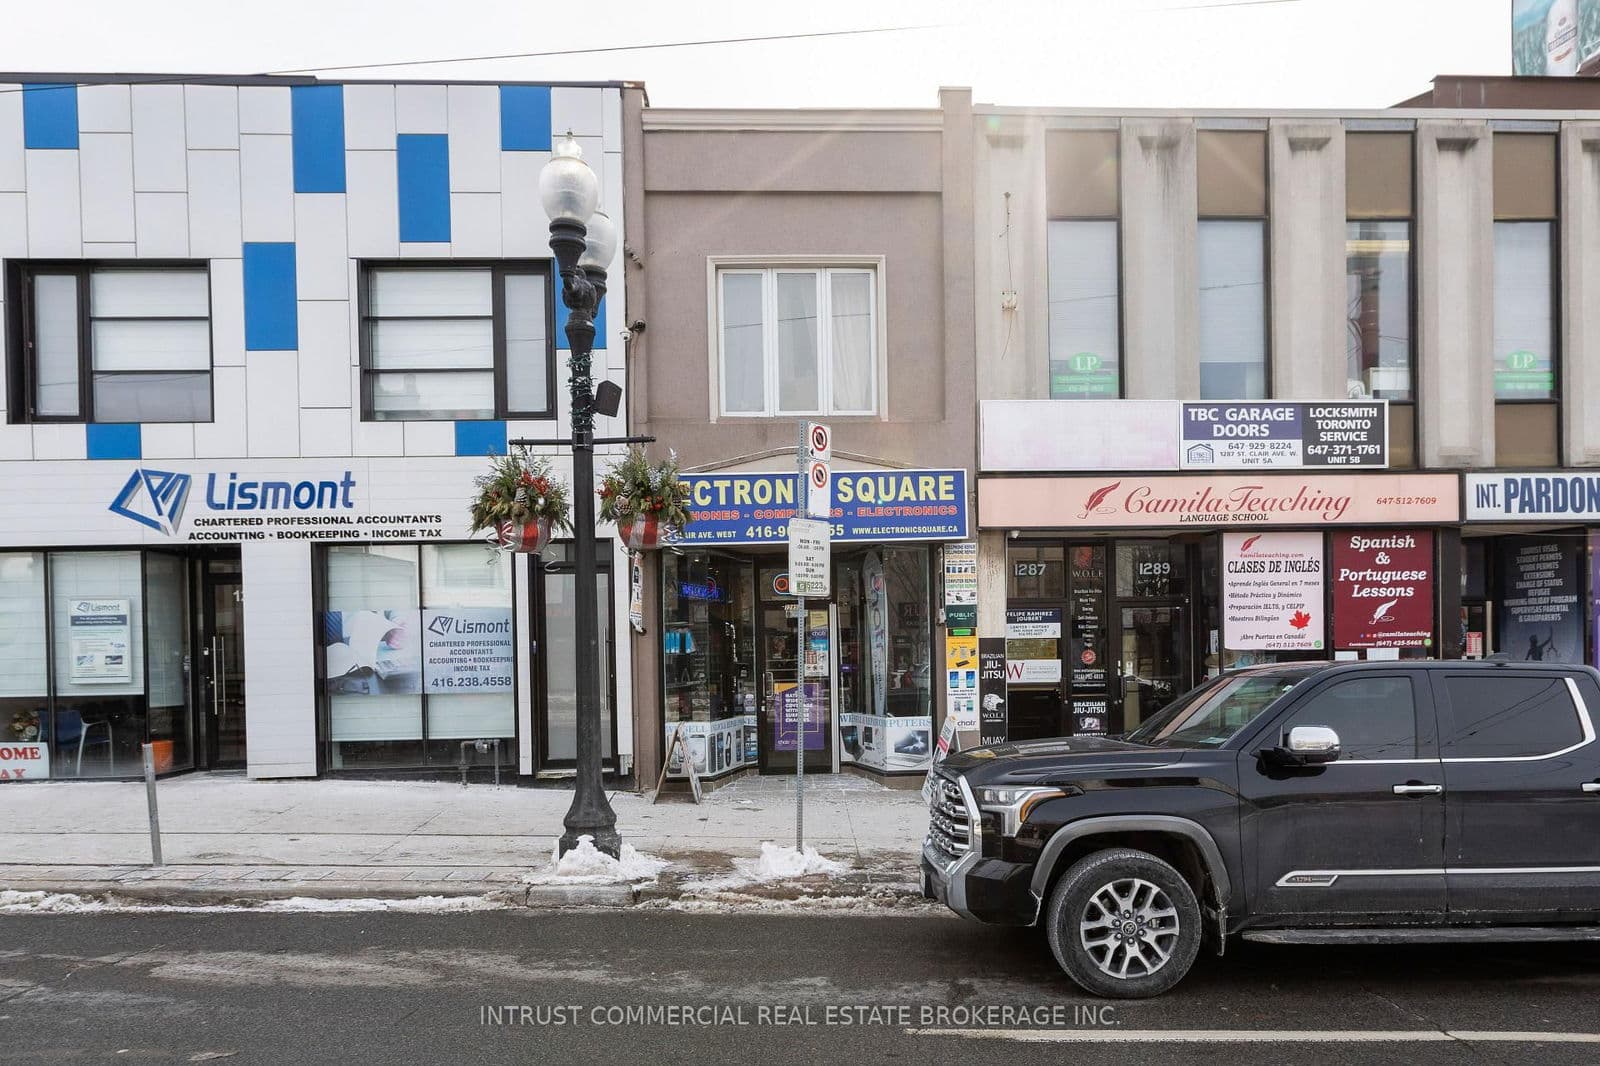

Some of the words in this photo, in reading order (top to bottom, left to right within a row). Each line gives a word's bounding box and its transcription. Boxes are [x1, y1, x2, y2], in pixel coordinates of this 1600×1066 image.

[1076, 356, 1097, 371] LP
[1512, 354, 1534, 369] LP
[1188, 408, 1219, 421] TBC
[1225, 407, 1295, 421] GARAGE
[1309, 407, 1377, 418] LOCKSMITH
[1212, 423, 1270, 437] DOORS
[1315, 419, 1371, 430] TORONTO
[1319, 431, 1368, 442] SERVICE
[1307, 444, 1381, 455] 647-371-1761
[1327, 456, 1347, 464] UNIT
[1350, 456, 1361, 464] 5B
[205, 471, 357, 510] Lismont
[837, 475, 955, 504] SQUARE
[1476, 483, 1501, 509] INT.
[1504, 477, 1600, 514] PARDON
[1124, 486, 1224, 514] Camila
[1225, 485, 1352, 521] Teaching
[1376, 497, 1437, 505] 647-512-7609
[689, 509, 741, 521] HONES
[753, 506, 844, 520] COMPRS
[856, 505, 958, 517] ELECTRONICS
[1179, 513, 1230, 522] LANGUAGE
[1232, 513, 1269, 521] SCHOOL
[193, 515, 264, 527] CHARTERED
[266, 515, 355, 526] PROFESSIONAL
[356, 513, 443, 525] ACCOUNTANTS
[188, 530, 266, 541] ACCOUNTING
[276, 529, 360, 540] BOOKKEEPING
[371, 528, 417, 539] INCOME
[419, 528, 443, 538] TAX
[697, 530, 715, 539] AVE.
[716, 530, 737, 538] WEST
[852, 525, 958, 535] WWW.ELECTRONICSQUARE.CA
[1350, 535, 1416, 552] Spanish
[1375, 551, 1391, 565] &
[1014, 563, 1047, 577] 1287
[1139, 562, 1171, 575] 1289
[1227, 560, 1265, 574] CLASES
[1268, 560, 1282, 573] DE
[1284, 556, 1320, 573] INGLÉS
[1338, 568, 1427, 584] Portuguese
[1352, 584, 1415, 597] Lessons
[455, 618, 511, 634] Lismont
[449, 648, 494, 656] ACCOUNTANTS
[429, 657, 468, 665] ACCOUNTING
[984, 661, 1002, 669] JIU-
[453, 665, 478, 673] INCOME
[981, 670, 1005, 680] JITSU
[1006, 662, 1025, 680] W
[431, 676, 512, 688] 416.238.4558
[1073, 706, 1106, 714] JIU-JITSU
[981, 736, 1005, 745] MUAY
